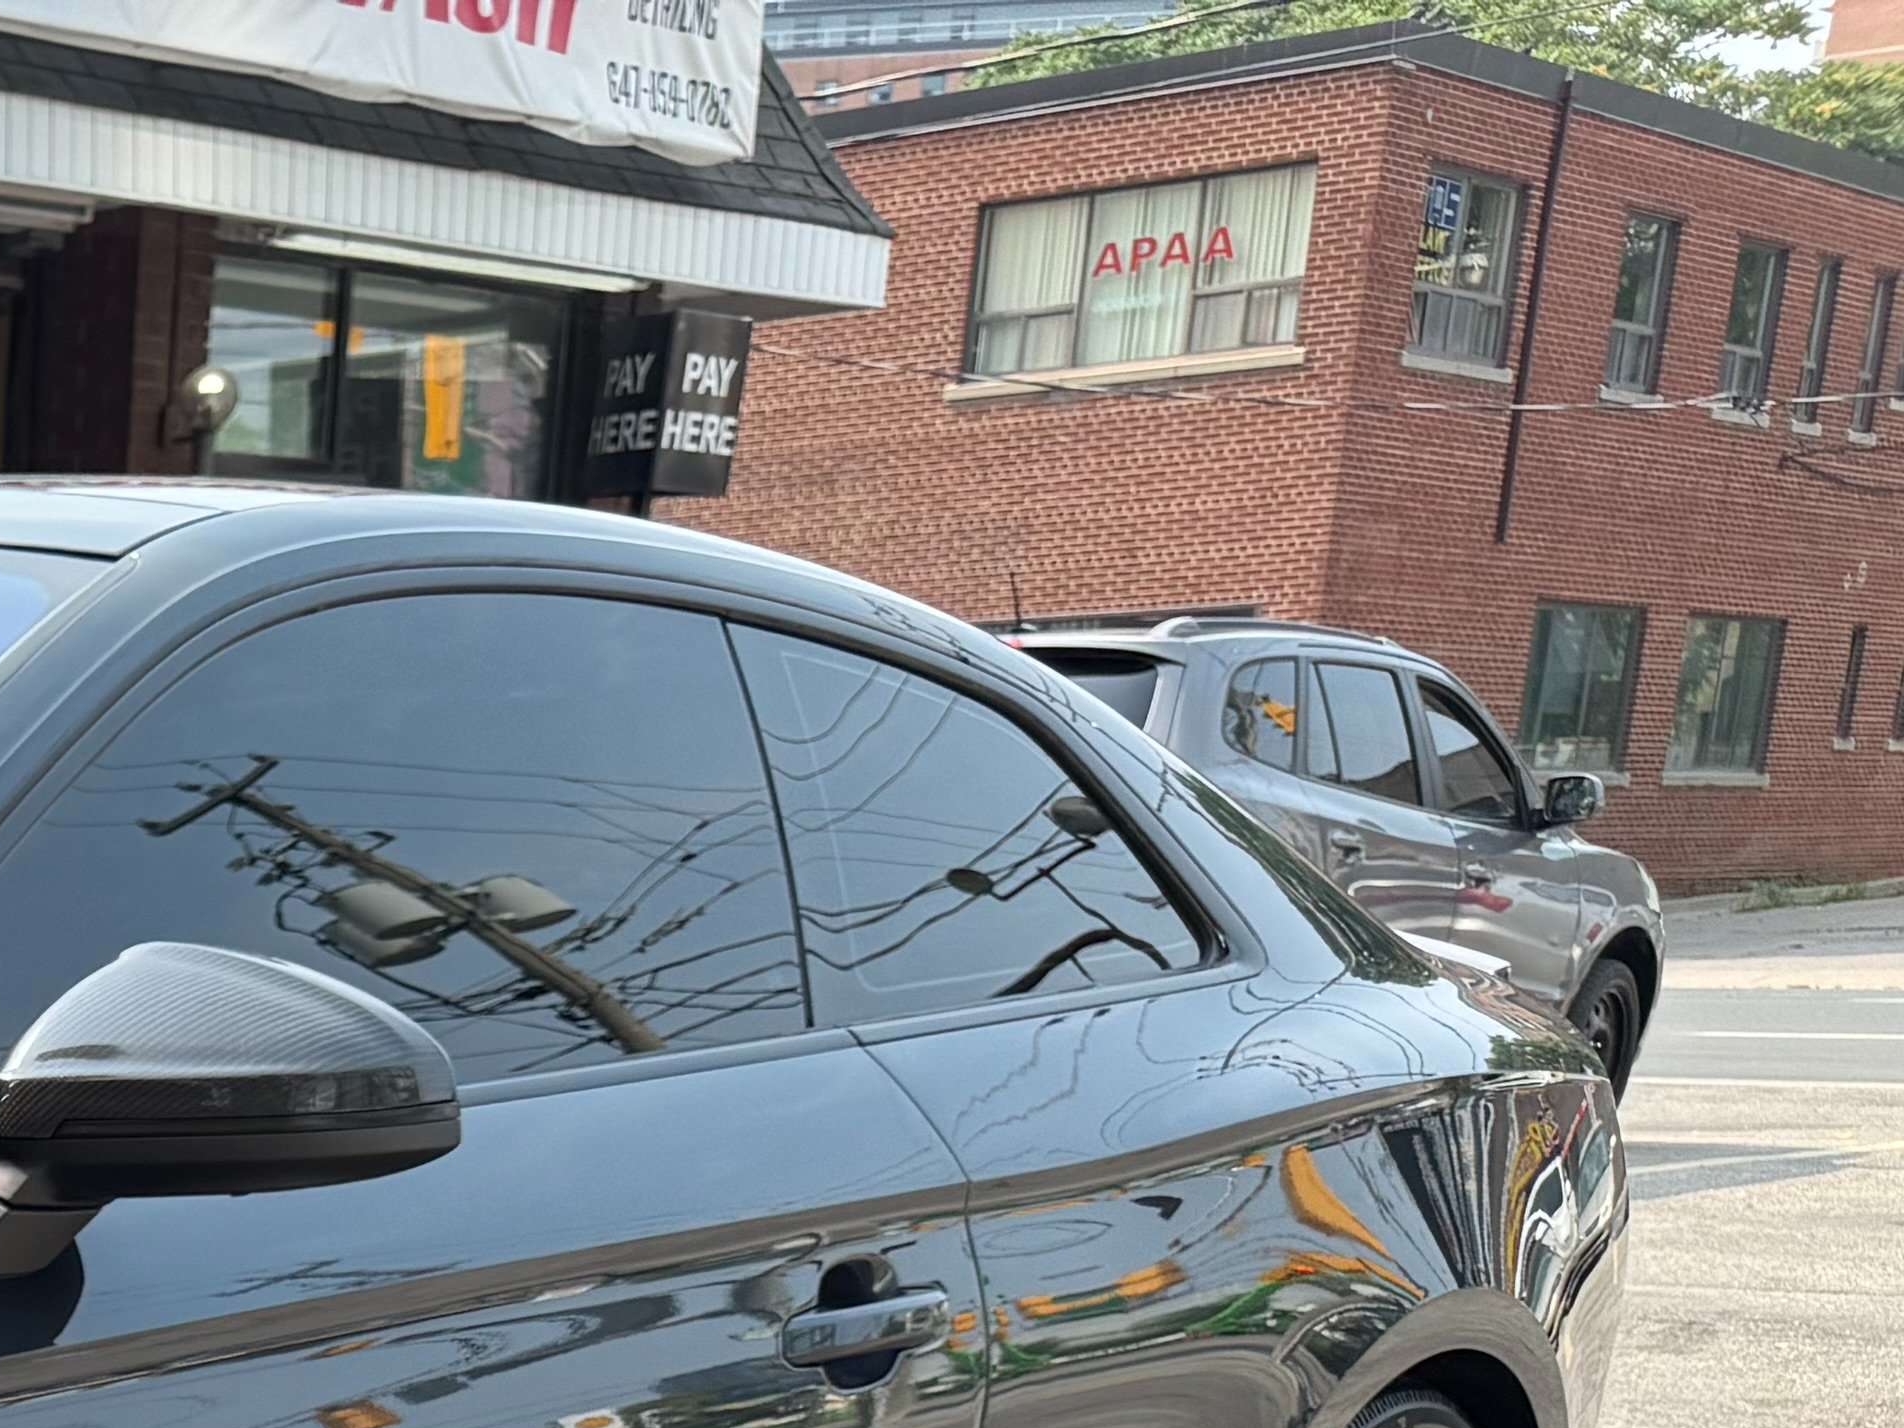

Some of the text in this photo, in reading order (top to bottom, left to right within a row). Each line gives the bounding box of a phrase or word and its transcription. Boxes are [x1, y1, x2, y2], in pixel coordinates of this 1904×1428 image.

[604, 352, 657, 397] PAY
[682, 352, 738, 398] PAY
[588, 409, 659, 456] HERE
[660, 408, 737, 457] HERE
